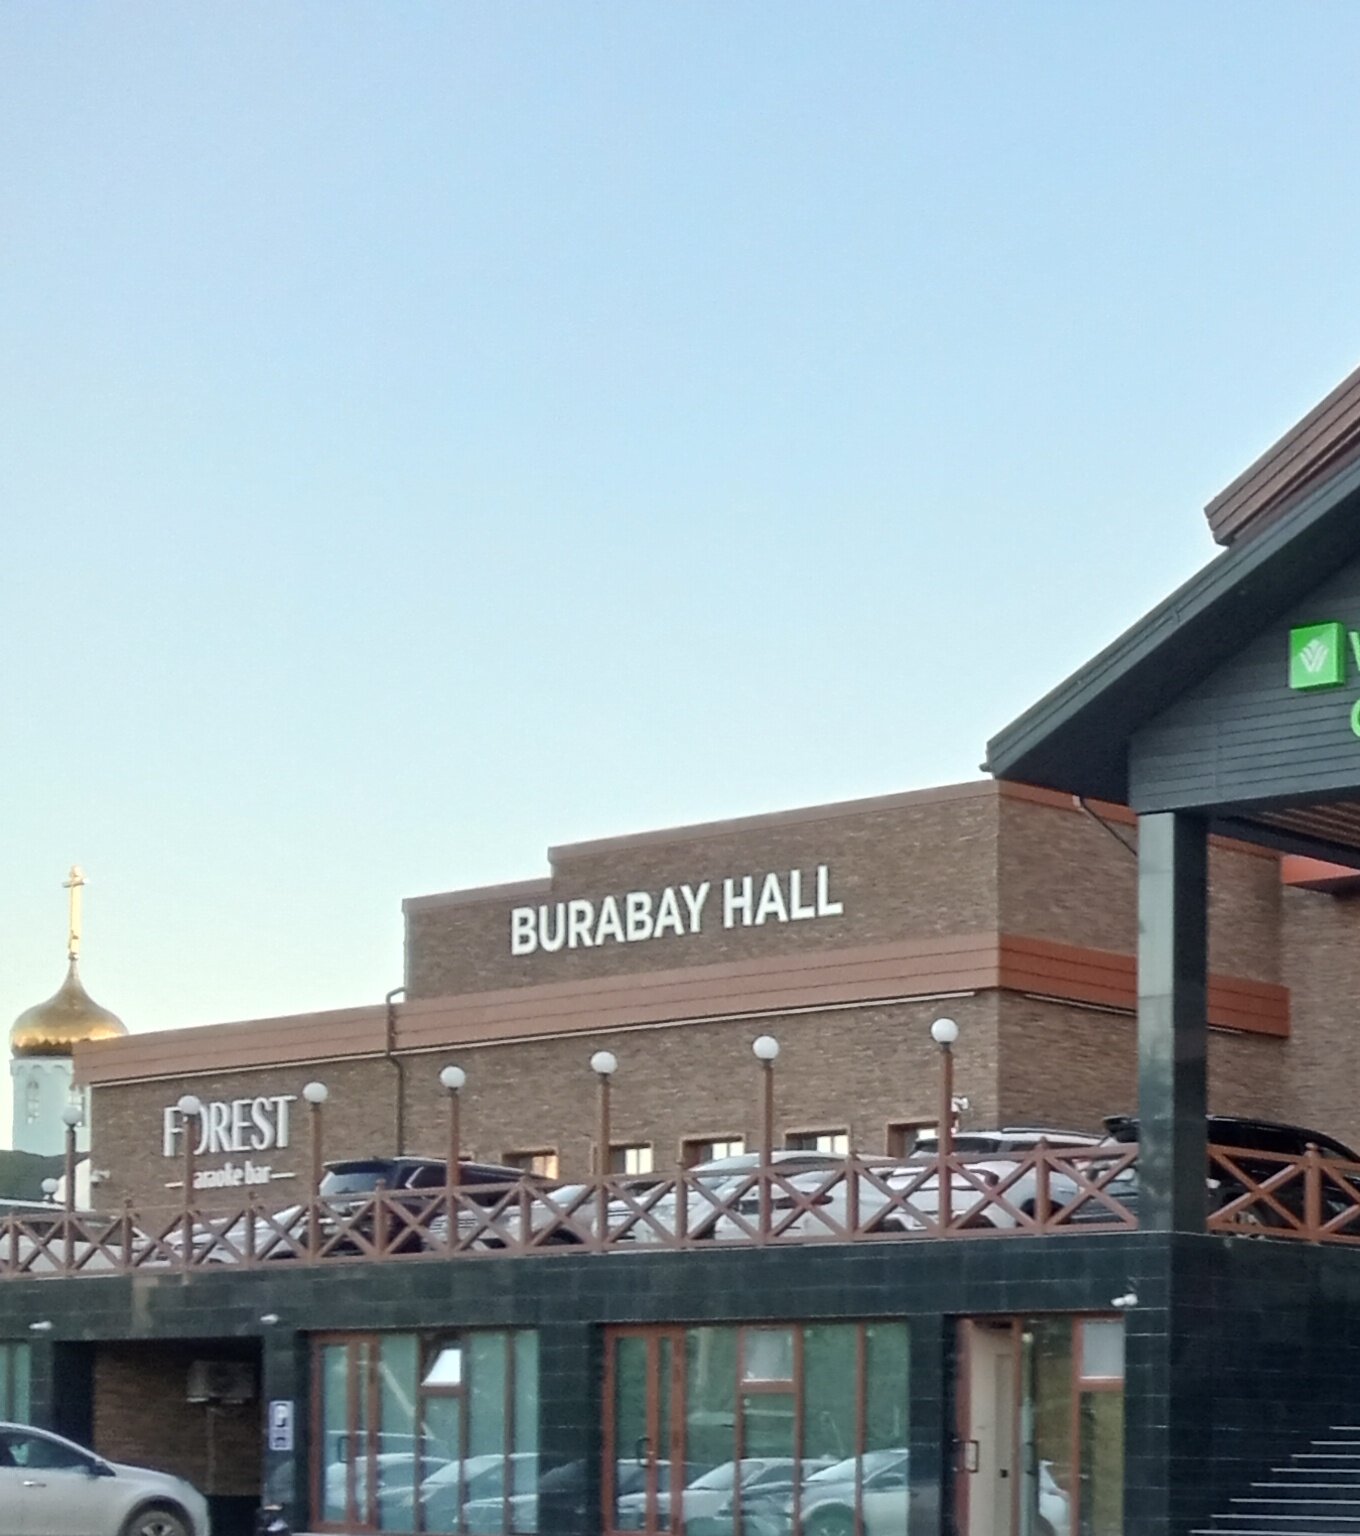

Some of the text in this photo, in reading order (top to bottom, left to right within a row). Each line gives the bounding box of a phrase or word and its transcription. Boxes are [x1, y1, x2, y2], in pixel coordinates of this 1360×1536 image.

[511, 865, 844, 956] BURABAY HALL
[192, 1160, 272, 1189] araoke bar
